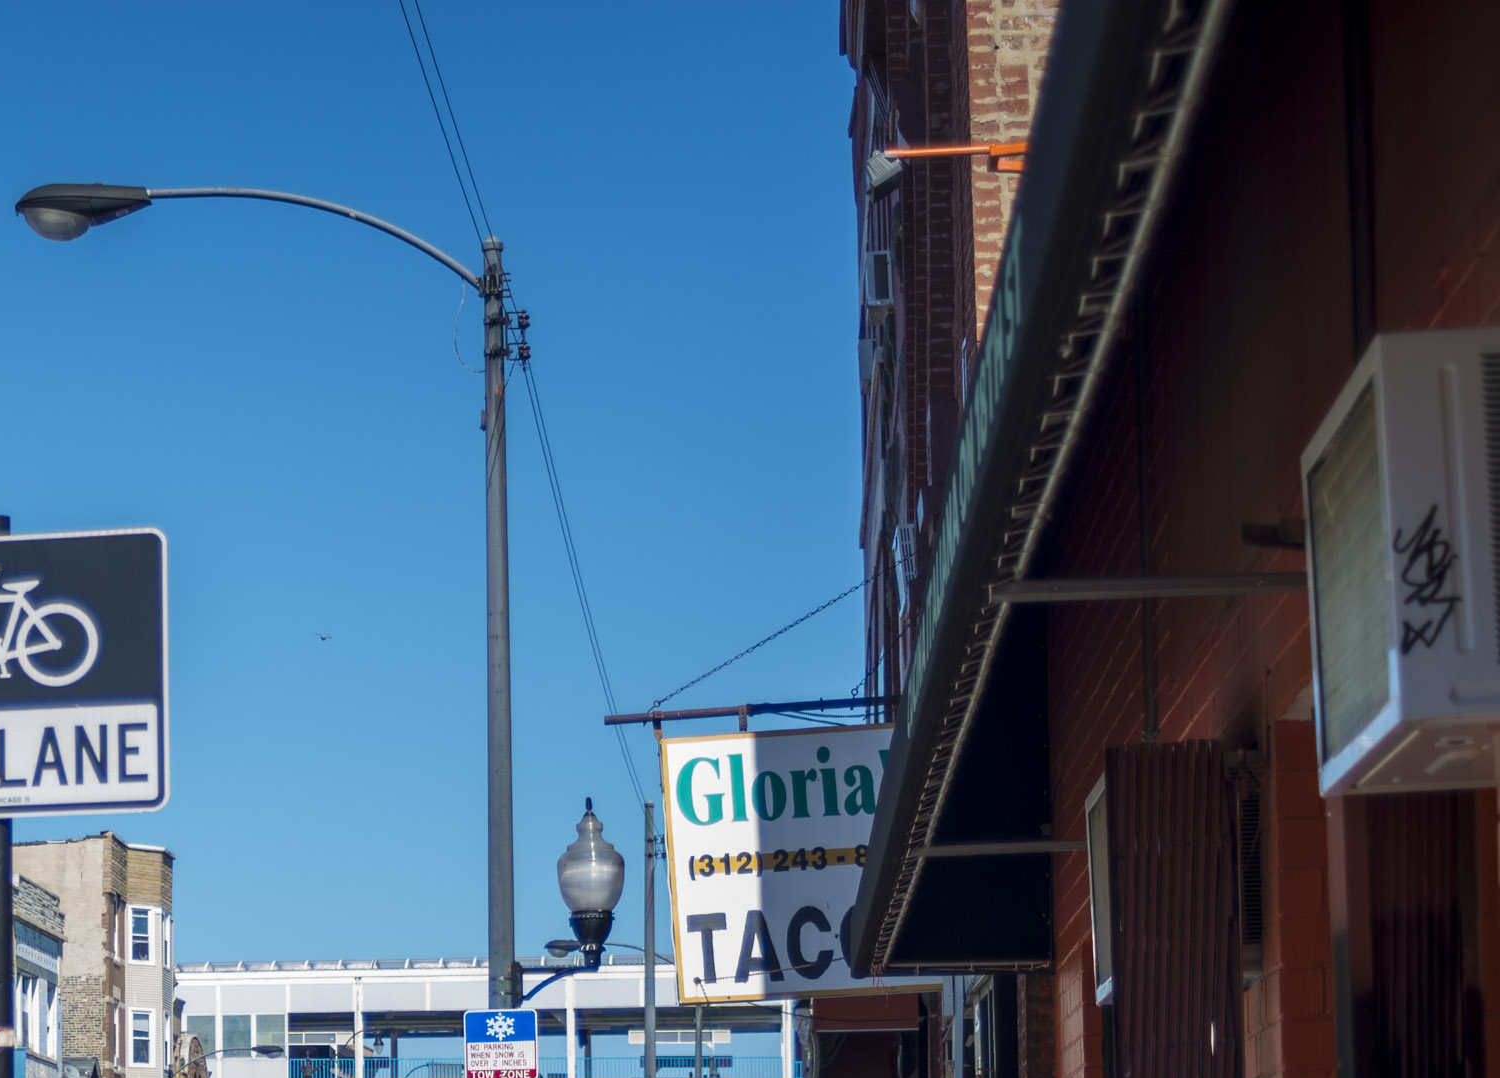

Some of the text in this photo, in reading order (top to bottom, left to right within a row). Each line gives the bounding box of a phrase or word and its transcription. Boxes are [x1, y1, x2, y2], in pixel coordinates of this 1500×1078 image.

[1003, 212, 1022, 361] ST
[688, 851, 763, 880] (312)
[483, 1043, 514, 1051] PARKING
[494, 1051, 514, 1059] SNOW
[501, 1059, 527, 1067] INCHES
